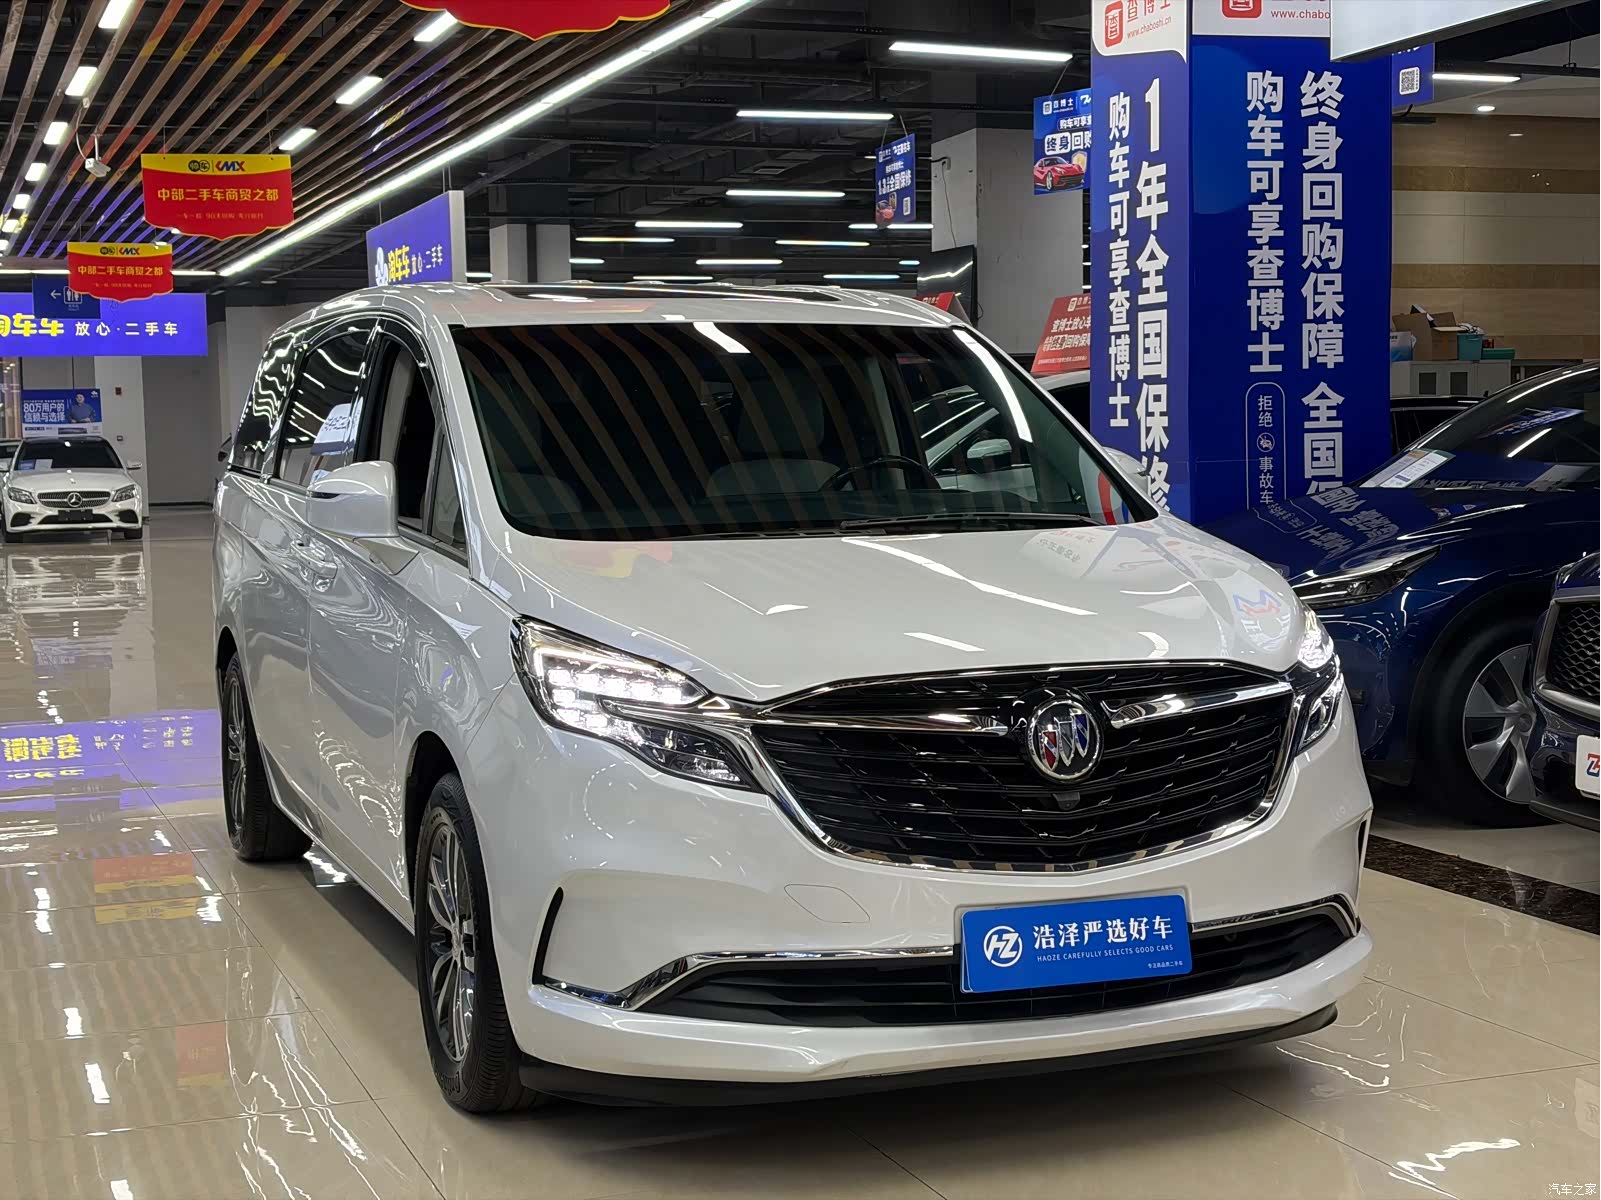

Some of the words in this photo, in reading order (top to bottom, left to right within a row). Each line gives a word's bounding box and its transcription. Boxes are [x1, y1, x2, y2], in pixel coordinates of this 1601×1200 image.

[1127, 16, 1172, 39] www.chaboshi.cn
[157, 188, 279, 201] 中部二手车商贸之都
[1247, 70, 1285, 373] 购车可享查博士
[1300, 70, 1345, 370] 终身回购保障
[77, 265, 164, 276] 中部二手车商贸之都
[1109, 92, 1131, 427] 购车可享查博士
[23, 402, 65, 412] 80万用户的
[24, 412, 66, 423] 信赖与选择
[1258, 395, 1273, 428] 拒绝
[1259, 456, 1274, 505] 事故车
[1033, 915, 1174, 950] 浩泽严选好车
[1037, 954, 1061, 962] HAOZE
[1063, 951, 1102, 960] CAREFULLY
[1104, 948, 1133, 957] SELECTS
[1135, 946, 1155, 954] GOOD
[1156, 944, 1174, 952] CARS
